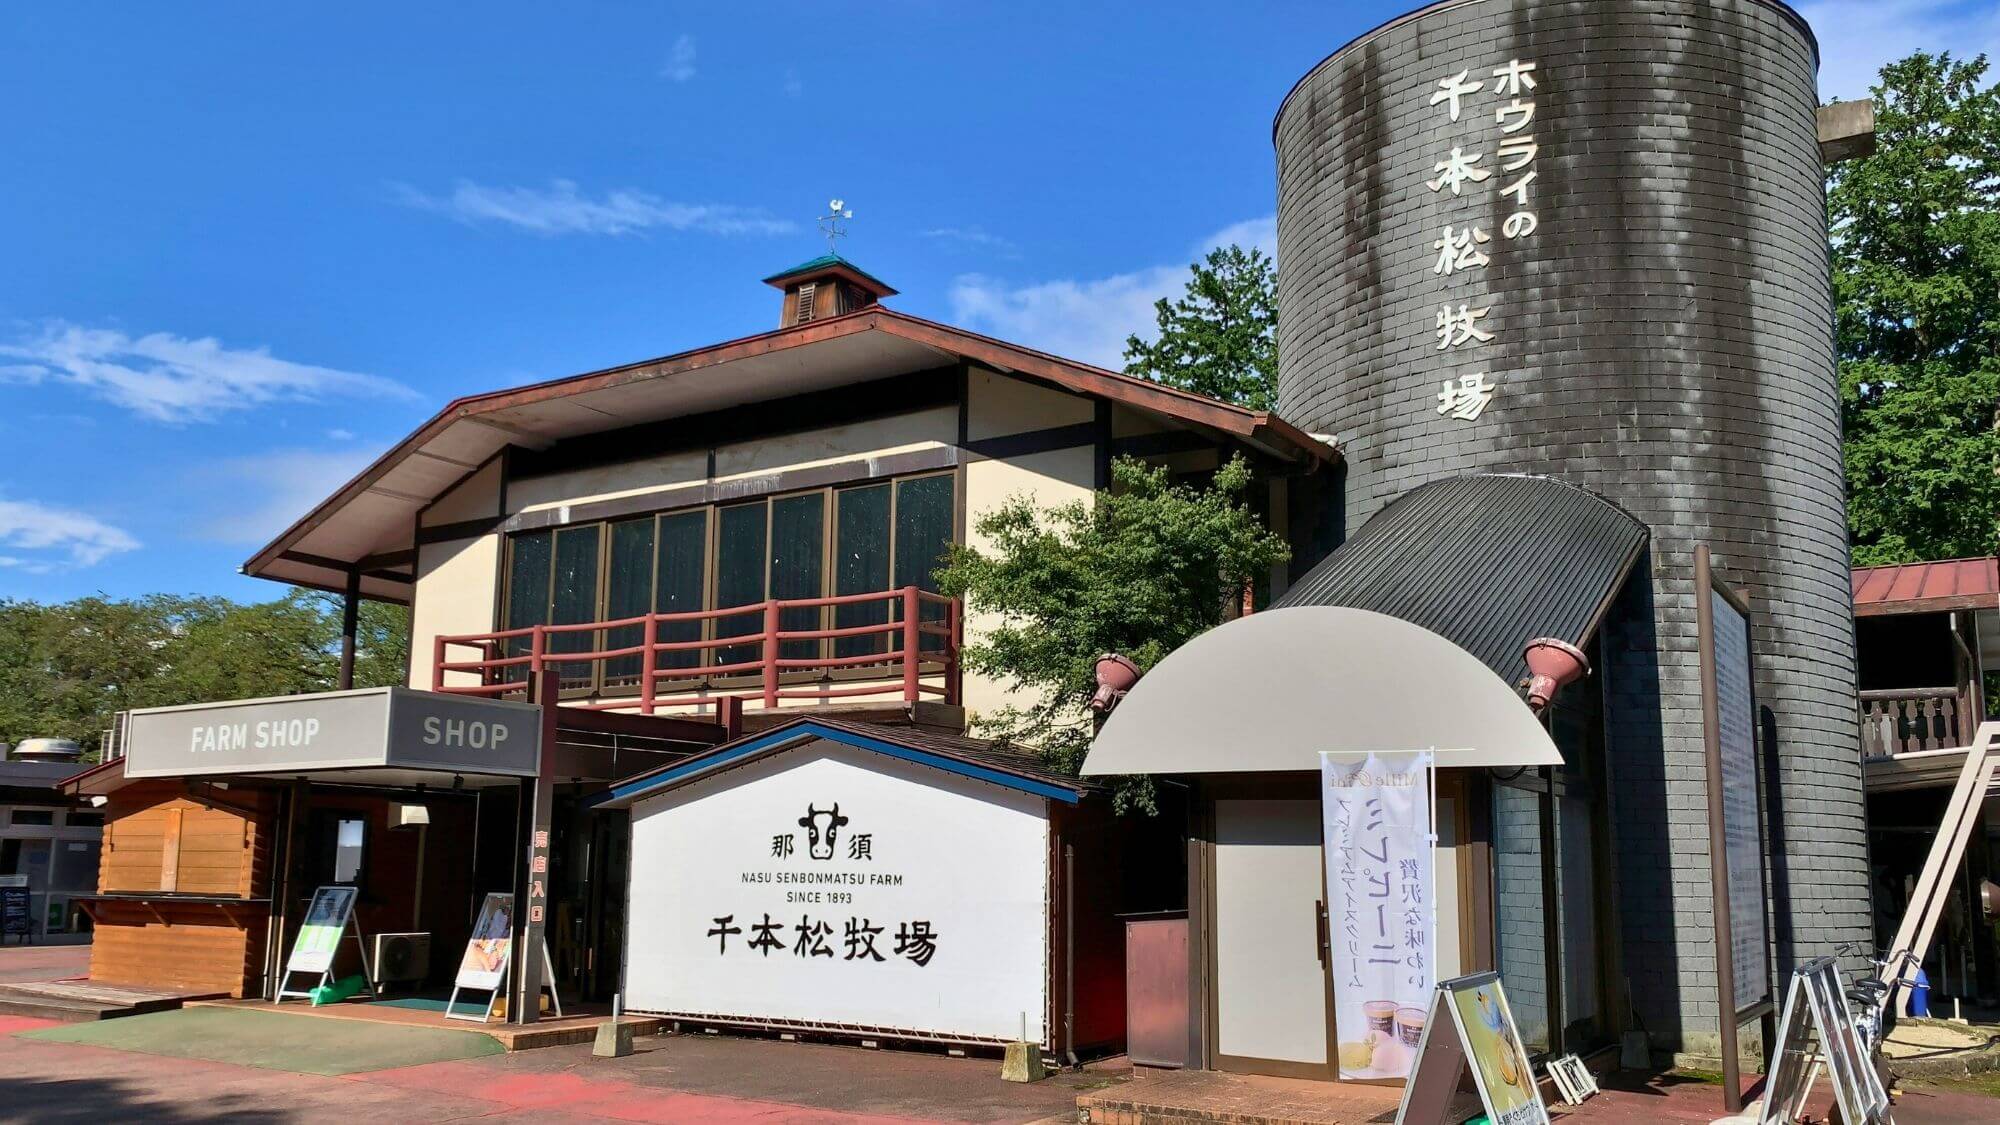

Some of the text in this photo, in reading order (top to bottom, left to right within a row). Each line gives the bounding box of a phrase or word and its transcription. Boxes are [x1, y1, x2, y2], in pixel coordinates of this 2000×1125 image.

[1493, 58, 1539, 240] ホウライの
[1426, 68, 1496, 422] 千本松牧場
[190, 717, 321, 753] FARM SHOP
[422, 716, 510, 751] SHOP
[741, 871, 904, 887] NASU SENBONMATSU FARM
[786, 891, 853, 905] SINCE 1893
[706, 913, 939, 968] 千本松牧場
